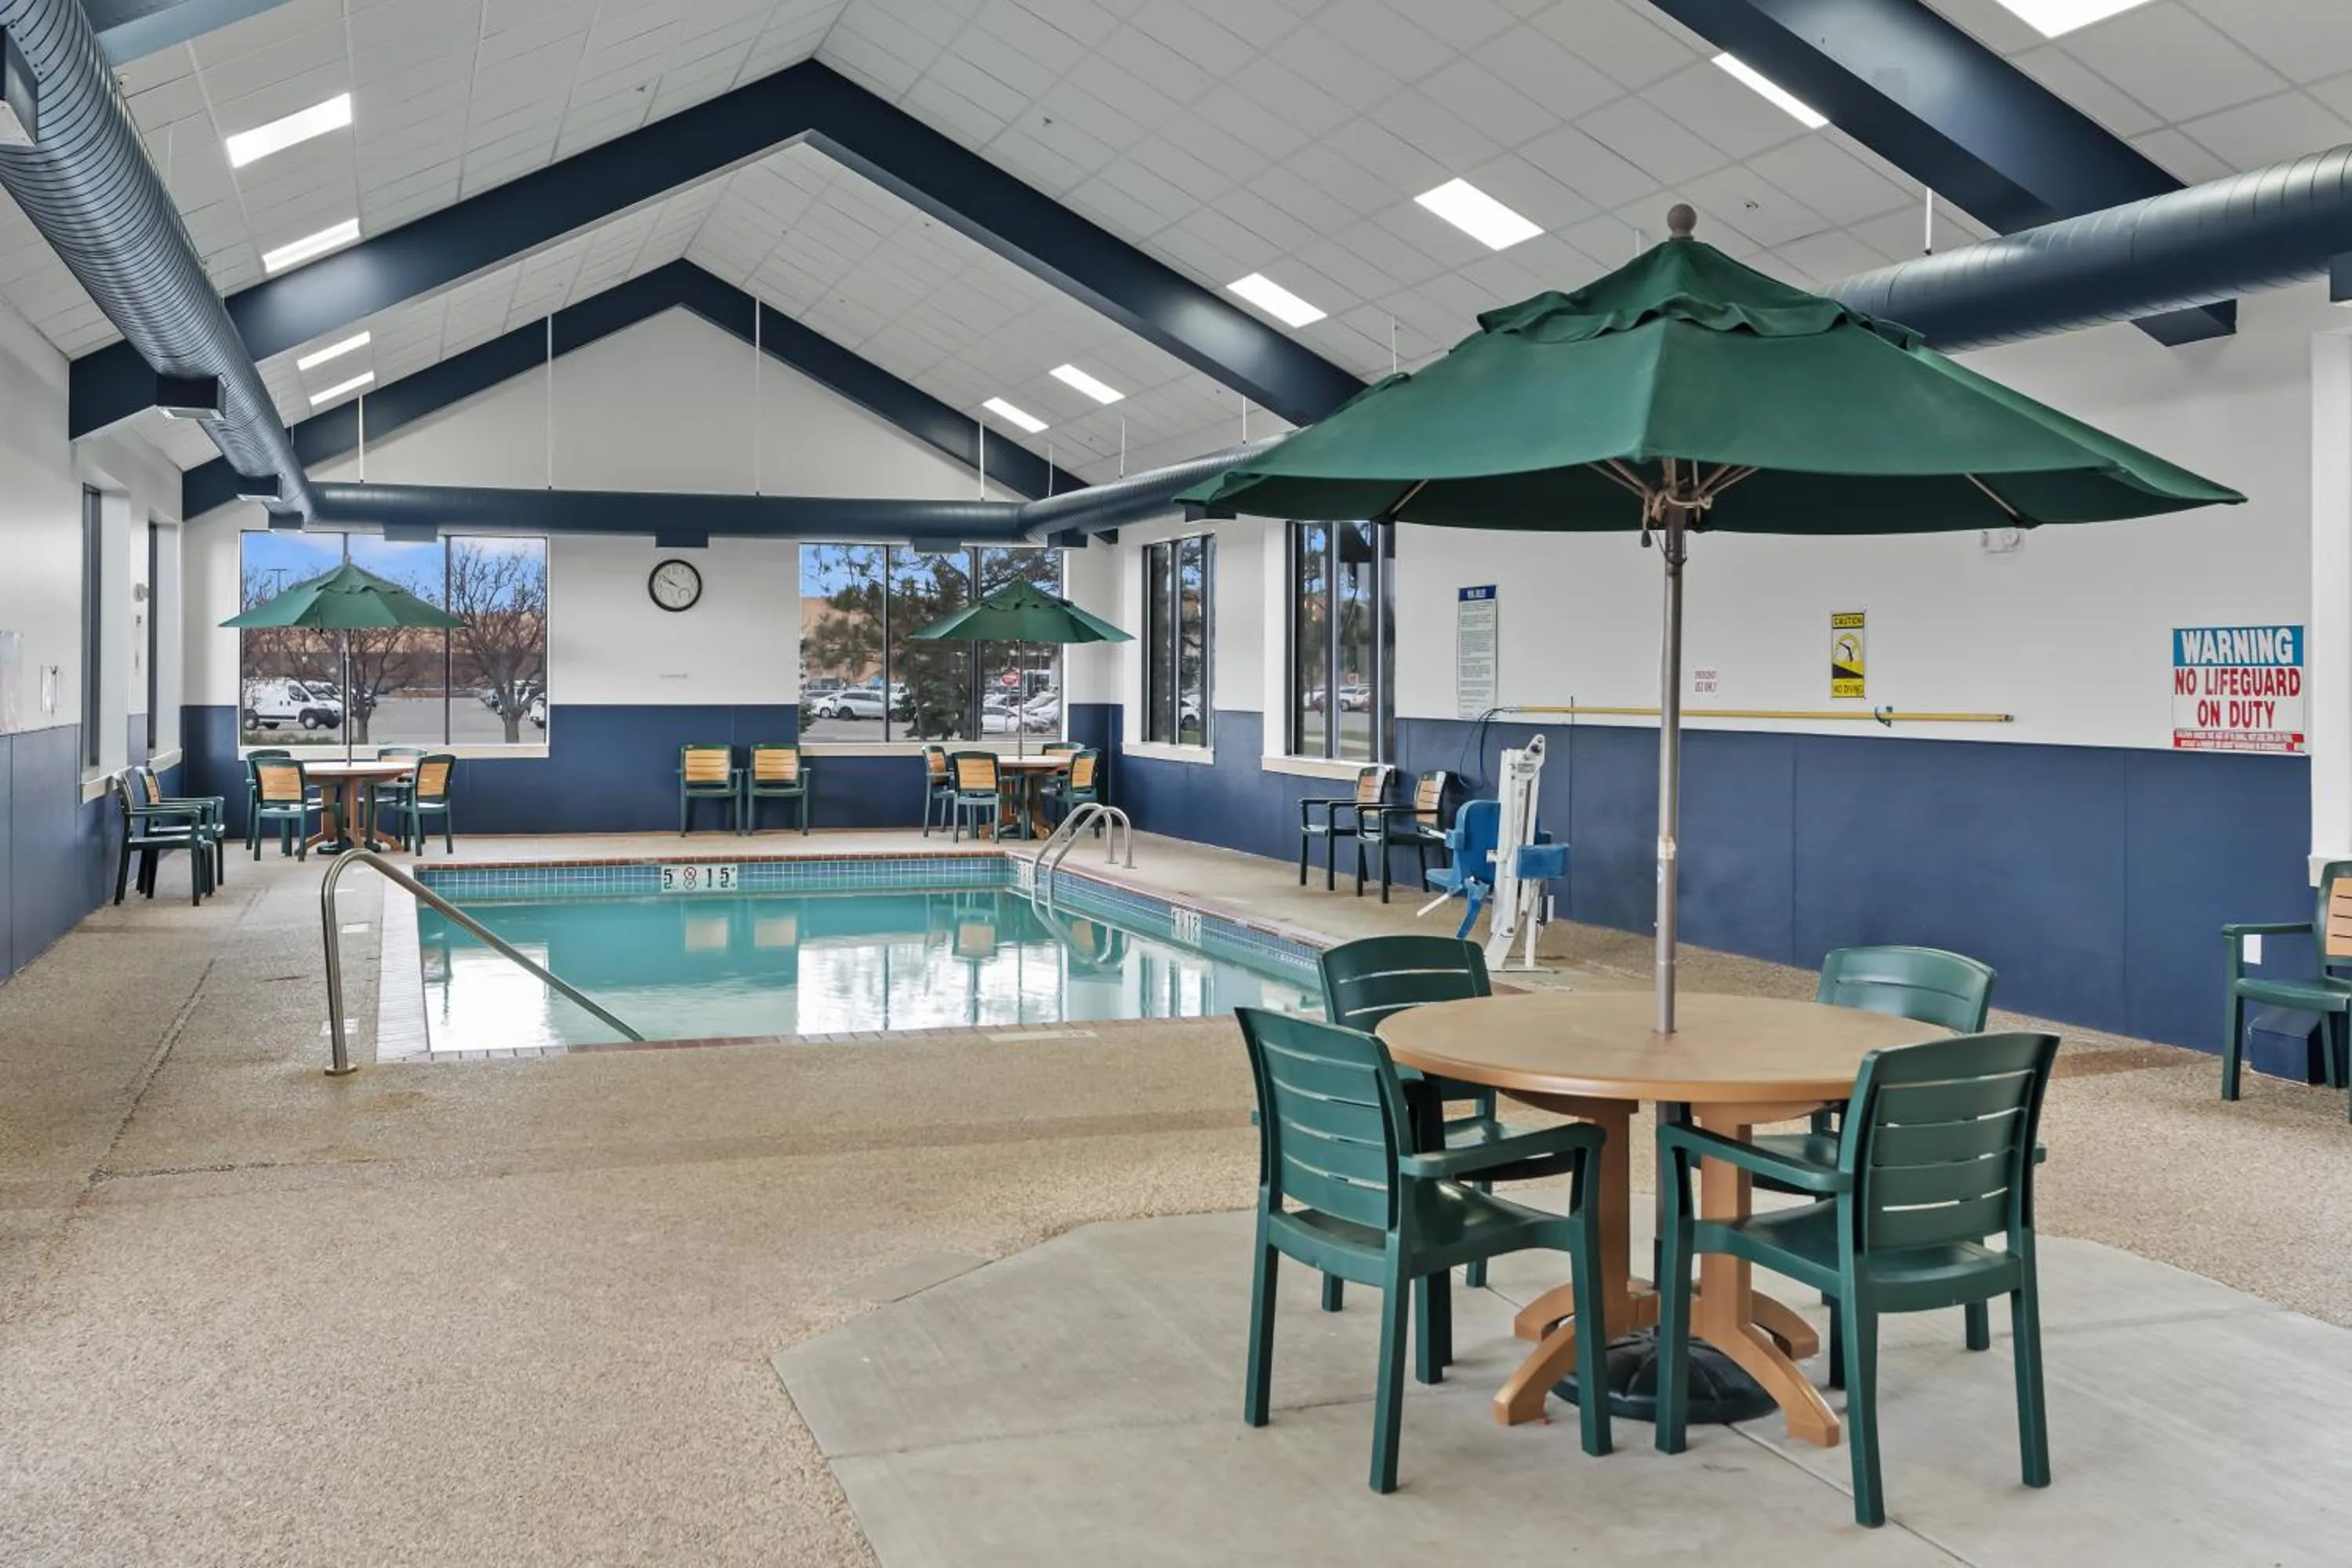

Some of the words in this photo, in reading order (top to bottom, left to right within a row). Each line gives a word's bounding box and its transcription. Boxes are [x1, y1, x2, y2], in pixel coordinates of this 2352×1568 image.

[2181, 628, 2293, 664] WARNING
[2175, 668, 2197, 695] NO
[2205, 668, 2300, 697] LIFEGUARD
[2198, 700, 2220, 728] ON
[2229, 700, 2276, 728] DUTY
